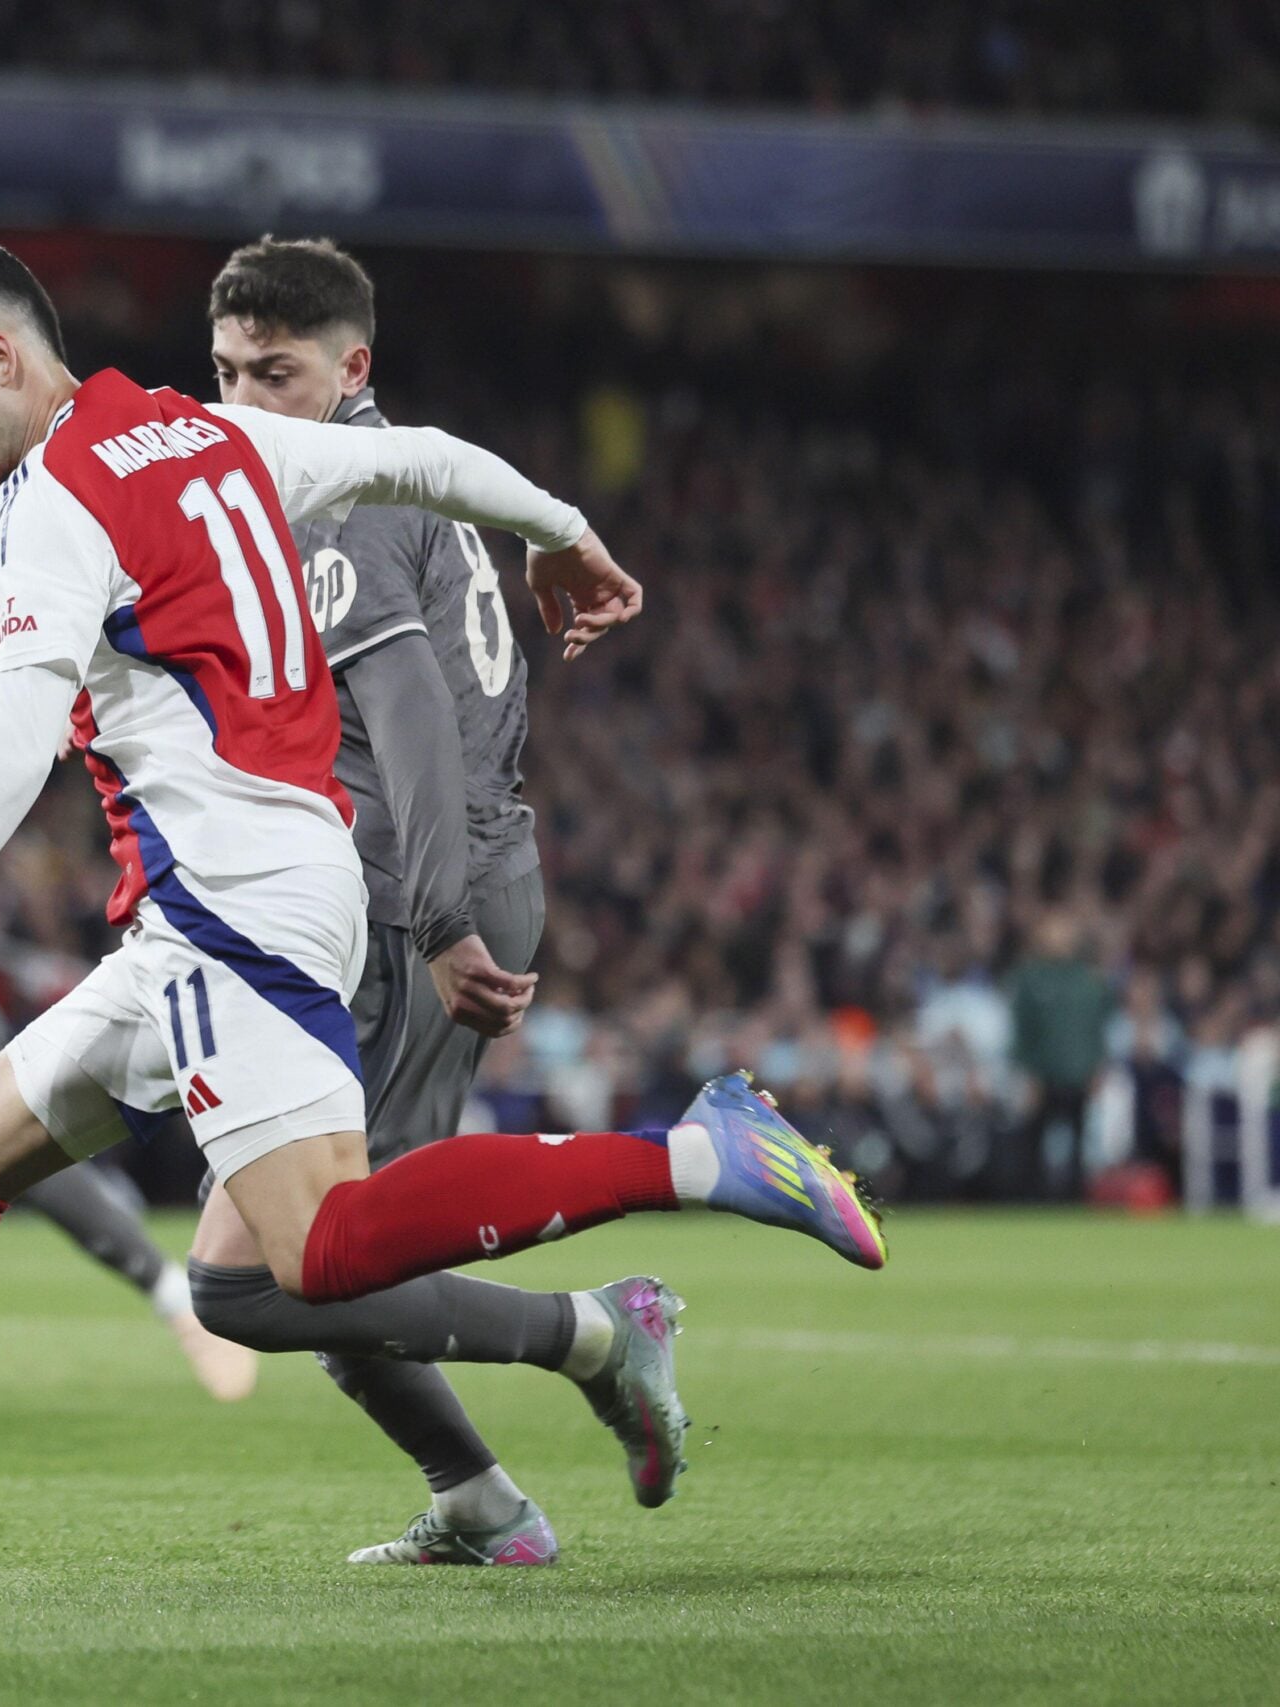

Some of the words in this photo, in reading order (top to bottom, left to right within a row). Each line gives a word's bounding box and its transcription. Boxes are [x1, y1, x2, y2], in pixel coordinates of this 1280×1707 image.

[177, 468, 307, 699] 11
[304, 548, 351, 633] hp
[452, 520, 514, 697] 8
[163, 964, 218, 1072] 11
